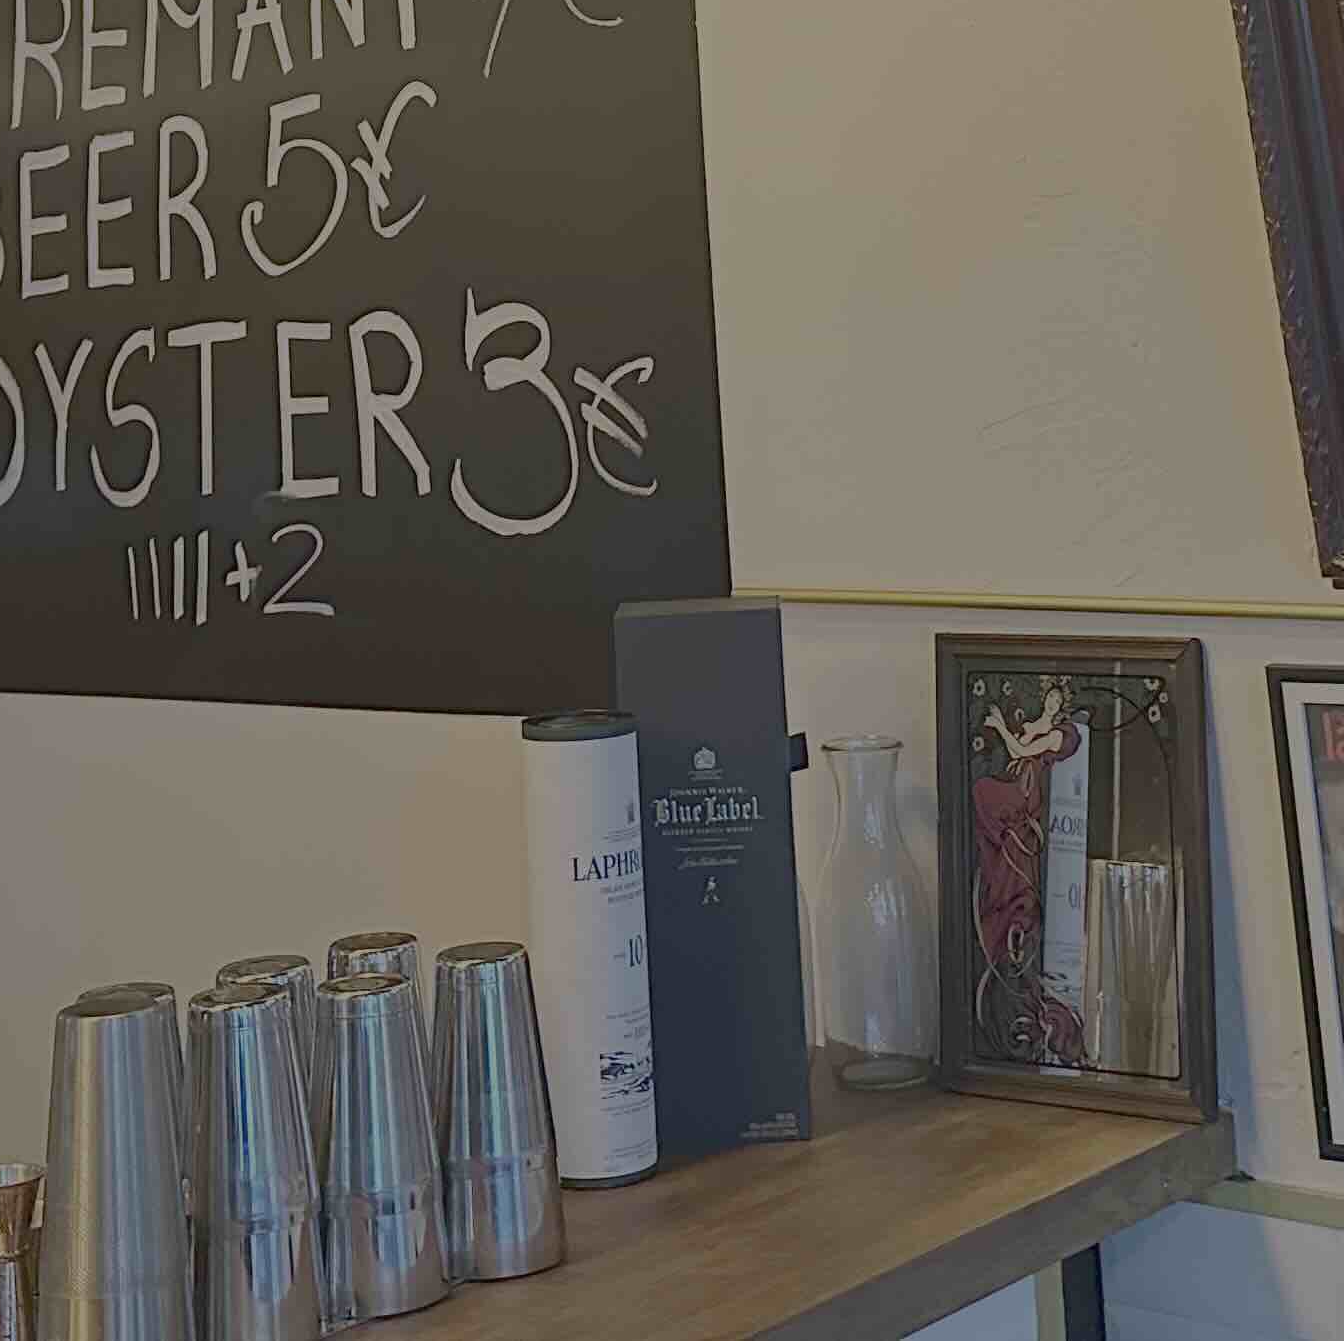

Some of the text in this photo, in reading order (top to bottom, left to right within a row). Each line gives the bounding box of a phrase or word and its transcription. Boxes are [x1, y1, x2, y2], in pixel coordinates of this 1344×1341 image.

[239, 79, 439, 277] 5€
[449, 285, 659, 538] 3€
[652, 795, 763, 827] Blue Label
[571, 848, 641, 883] LAPHR
[627, 933, 643, 969] 10
